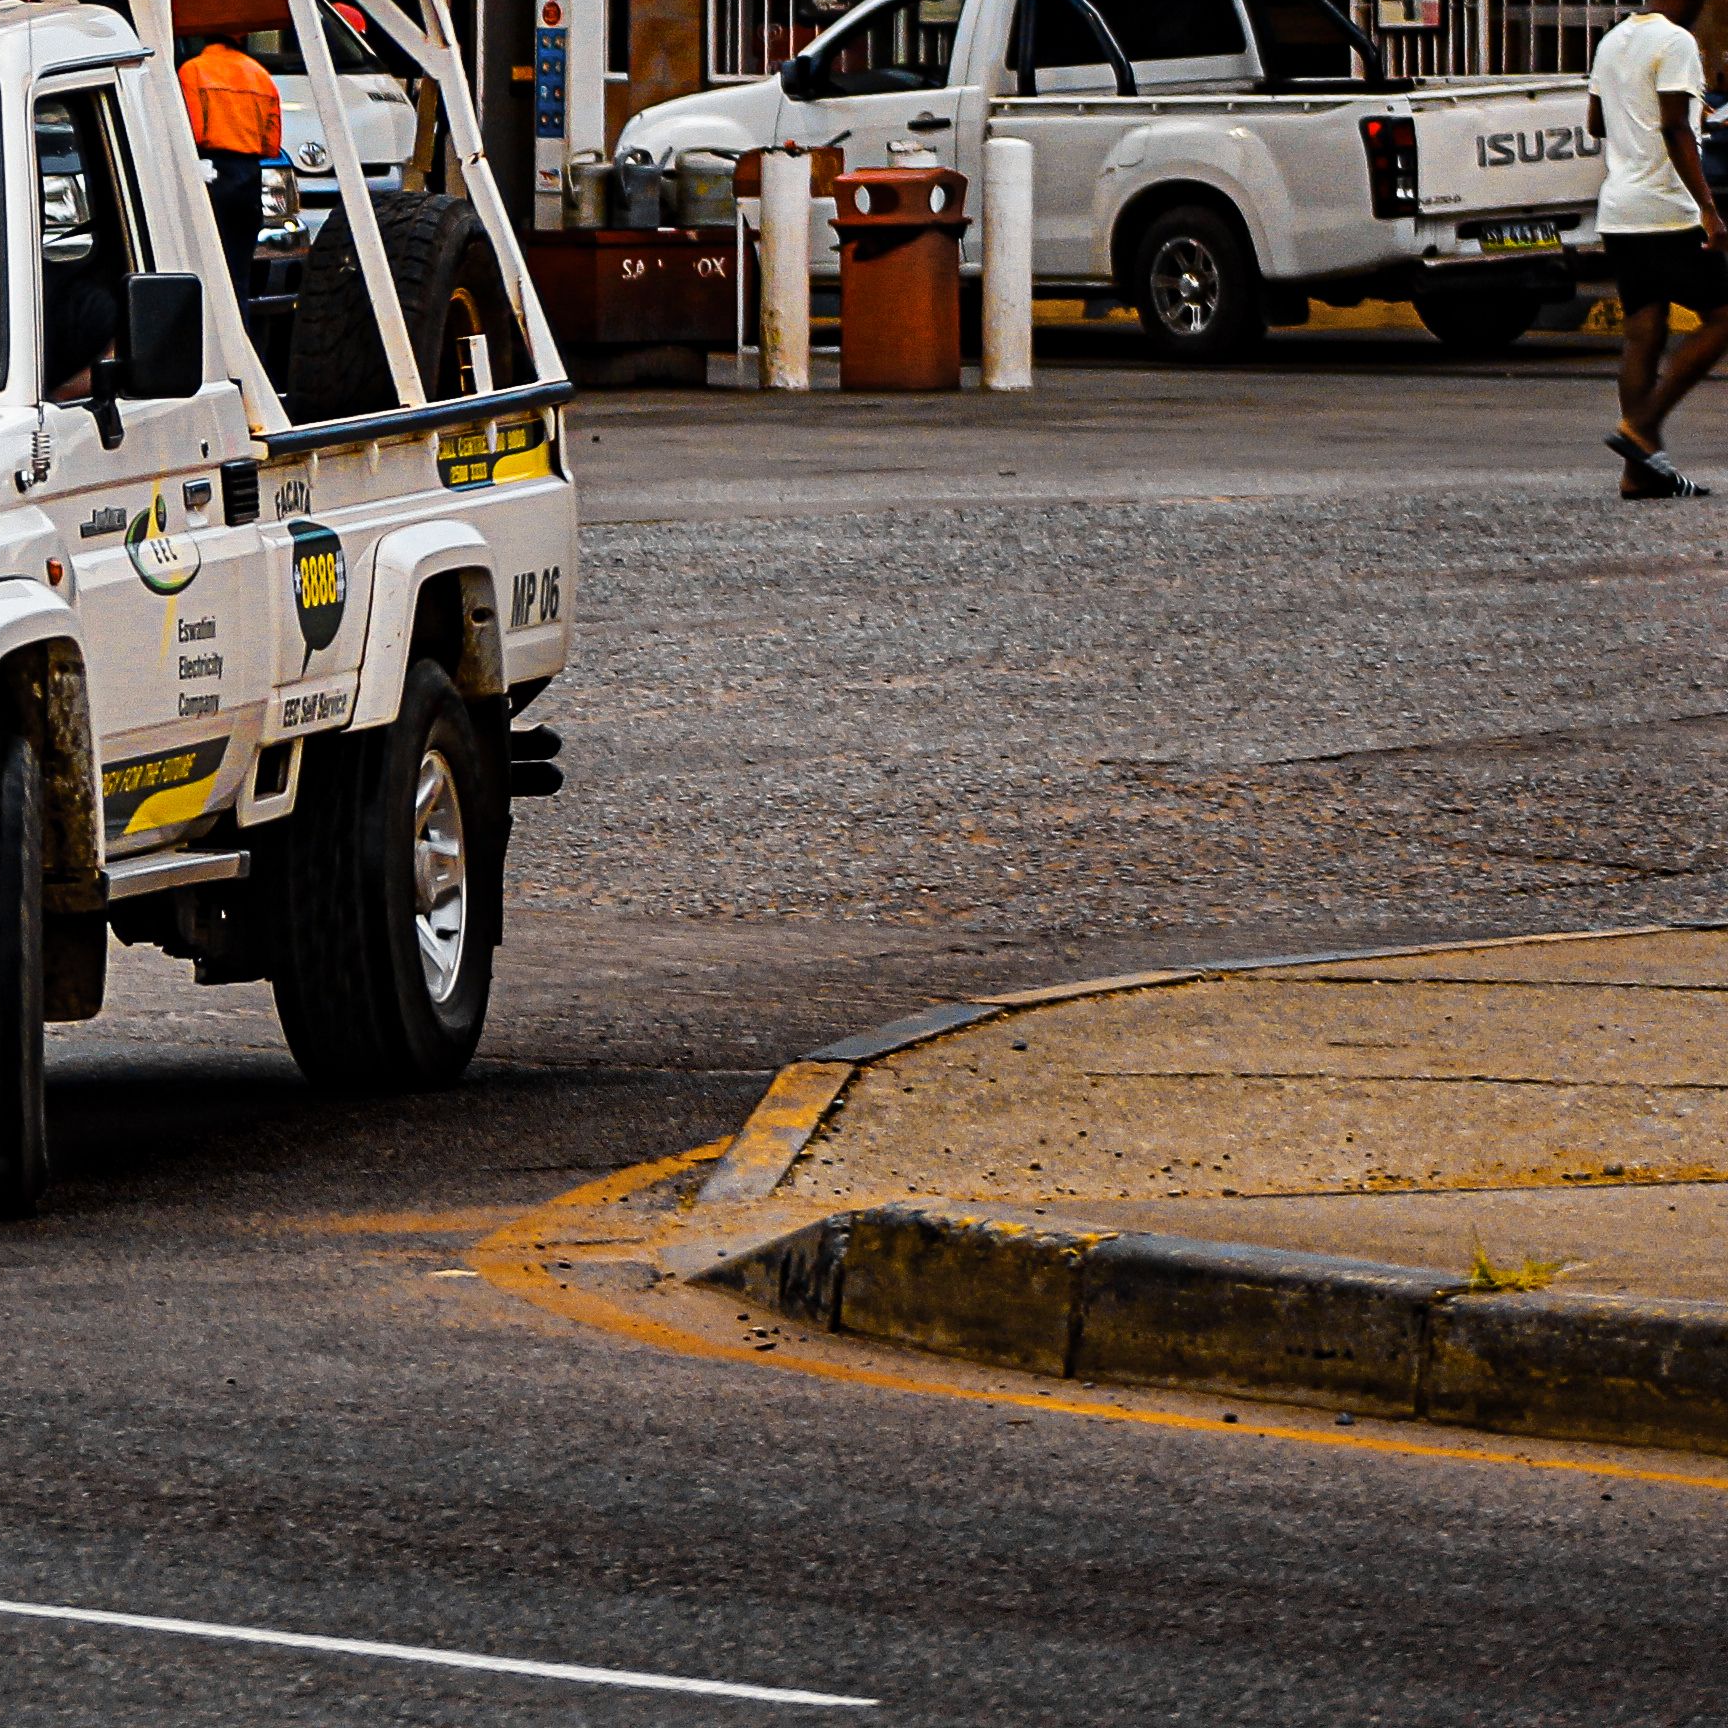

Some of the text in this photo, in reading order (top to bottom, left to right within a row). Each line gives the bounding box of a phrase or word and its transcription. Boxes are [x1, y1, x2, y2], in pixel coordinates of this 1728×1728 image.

[1476, 126, 1601, 168] ISUZU
[510, 565, 560, 628] MP 06
[178, 652, 223, 679] Electricity
[178, 692, 220, 718] Company
